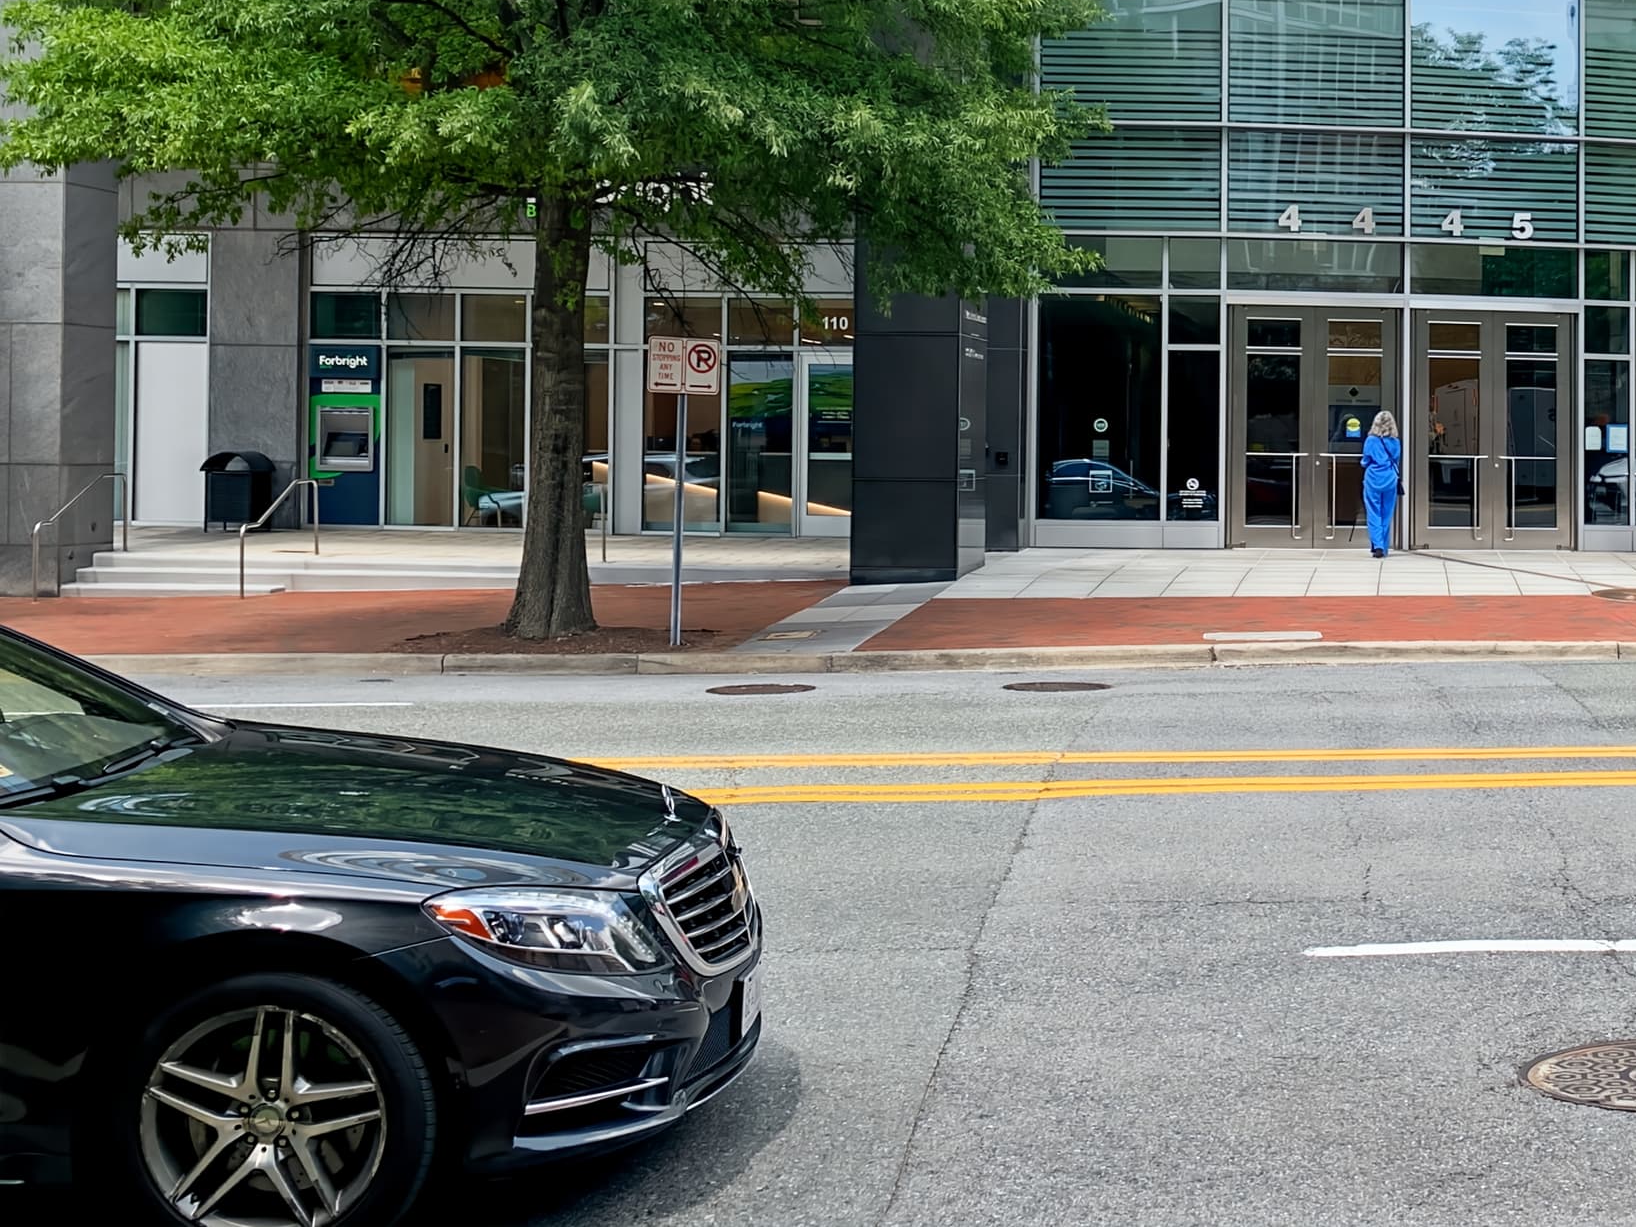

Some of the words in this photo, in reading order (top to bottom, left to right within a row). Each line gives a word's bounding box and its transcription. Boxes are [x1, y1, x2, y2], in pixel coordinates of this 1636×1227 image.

[822, 317, 849, 330] 110
[658, 341, 675, 353] NO
[319, 355, 369, 369] Forbright
[652, 353, 681, 362] STOPPING
[659, 363, 673, 371] ANY
[657, 372, 674, 380] TIME
